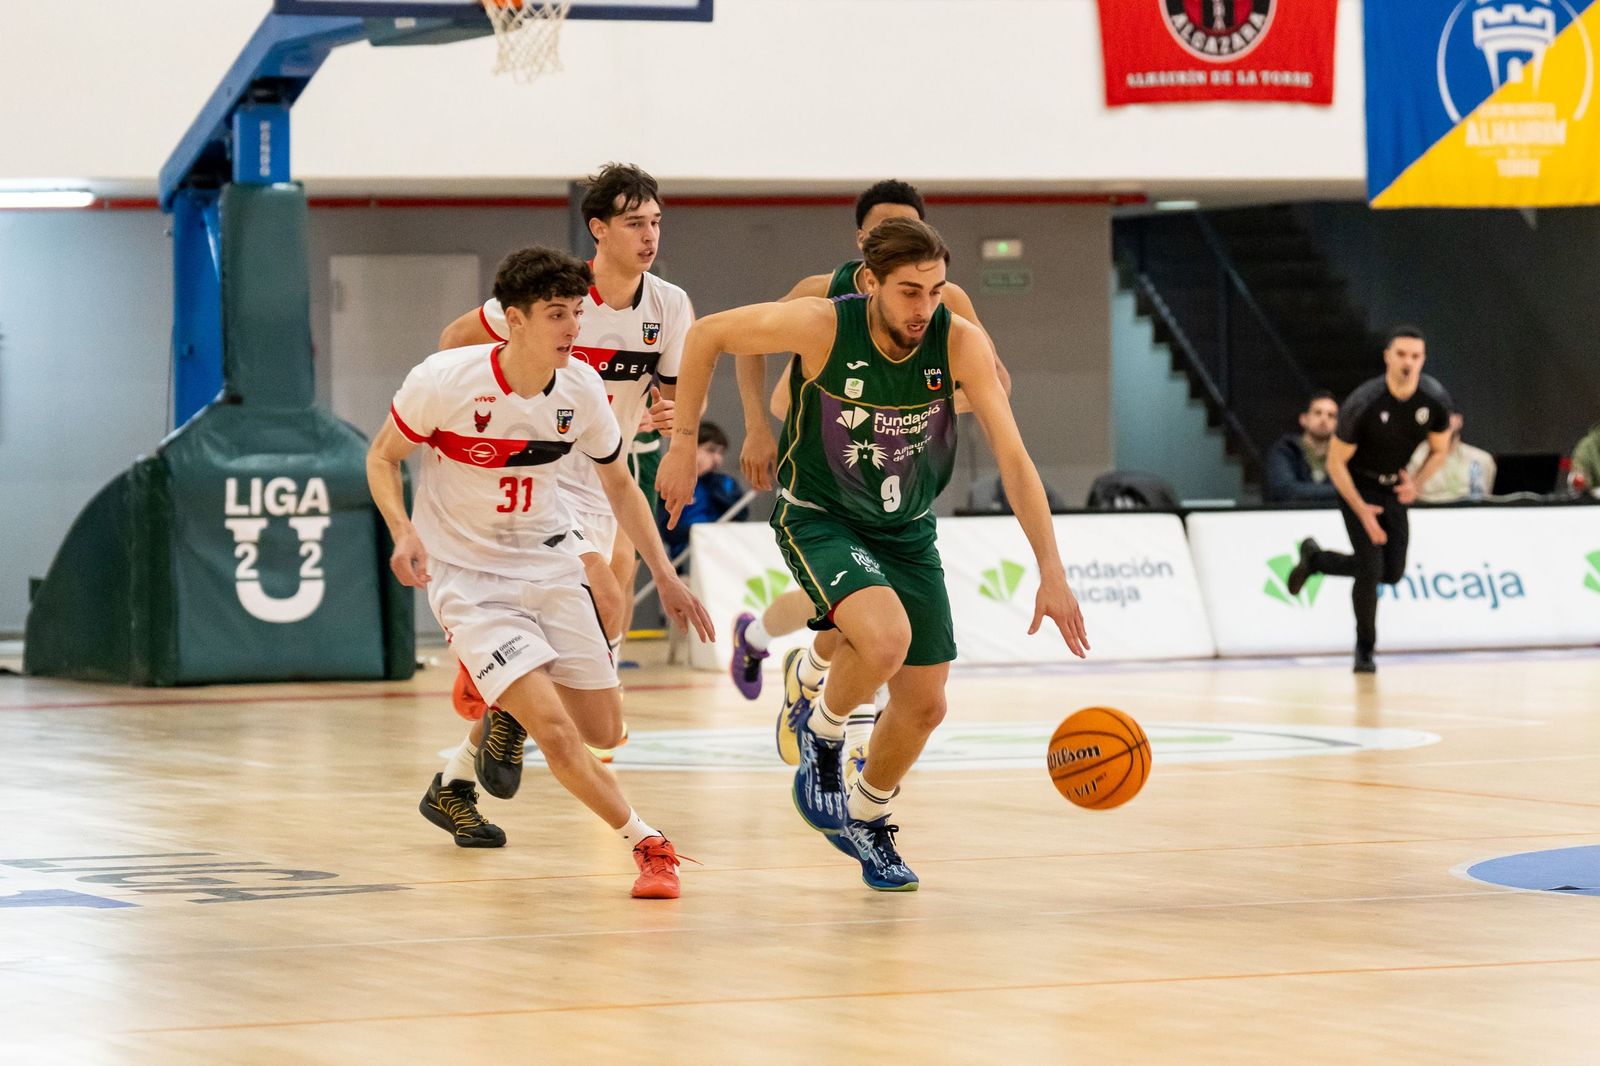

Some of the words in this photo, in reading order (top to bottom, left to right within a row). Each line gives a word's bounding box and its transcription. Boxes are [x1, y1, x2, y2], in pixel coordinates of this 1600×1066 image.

[1169, 13, 1267, 55] ALGAZARA
[1236, 70, 1258, 86] LA
[923, 368, 942, 376] LIGA
[873, 420, 929, 436] Unicaja
[874, 404, 941, 427] Fundació
[224, 477, 331, 517] LIGA
[496, 476, 534, 513] 31
[880, 475, 902, 513] 9
[1066, 556, 1175, 580] ndación
[1072, 581, 1141, 607] icaja
[1376, 562, 1525, 609] nicaja
[476, 662, 495, 680] vive
[1047, 745, 1101, 770] Wilson
